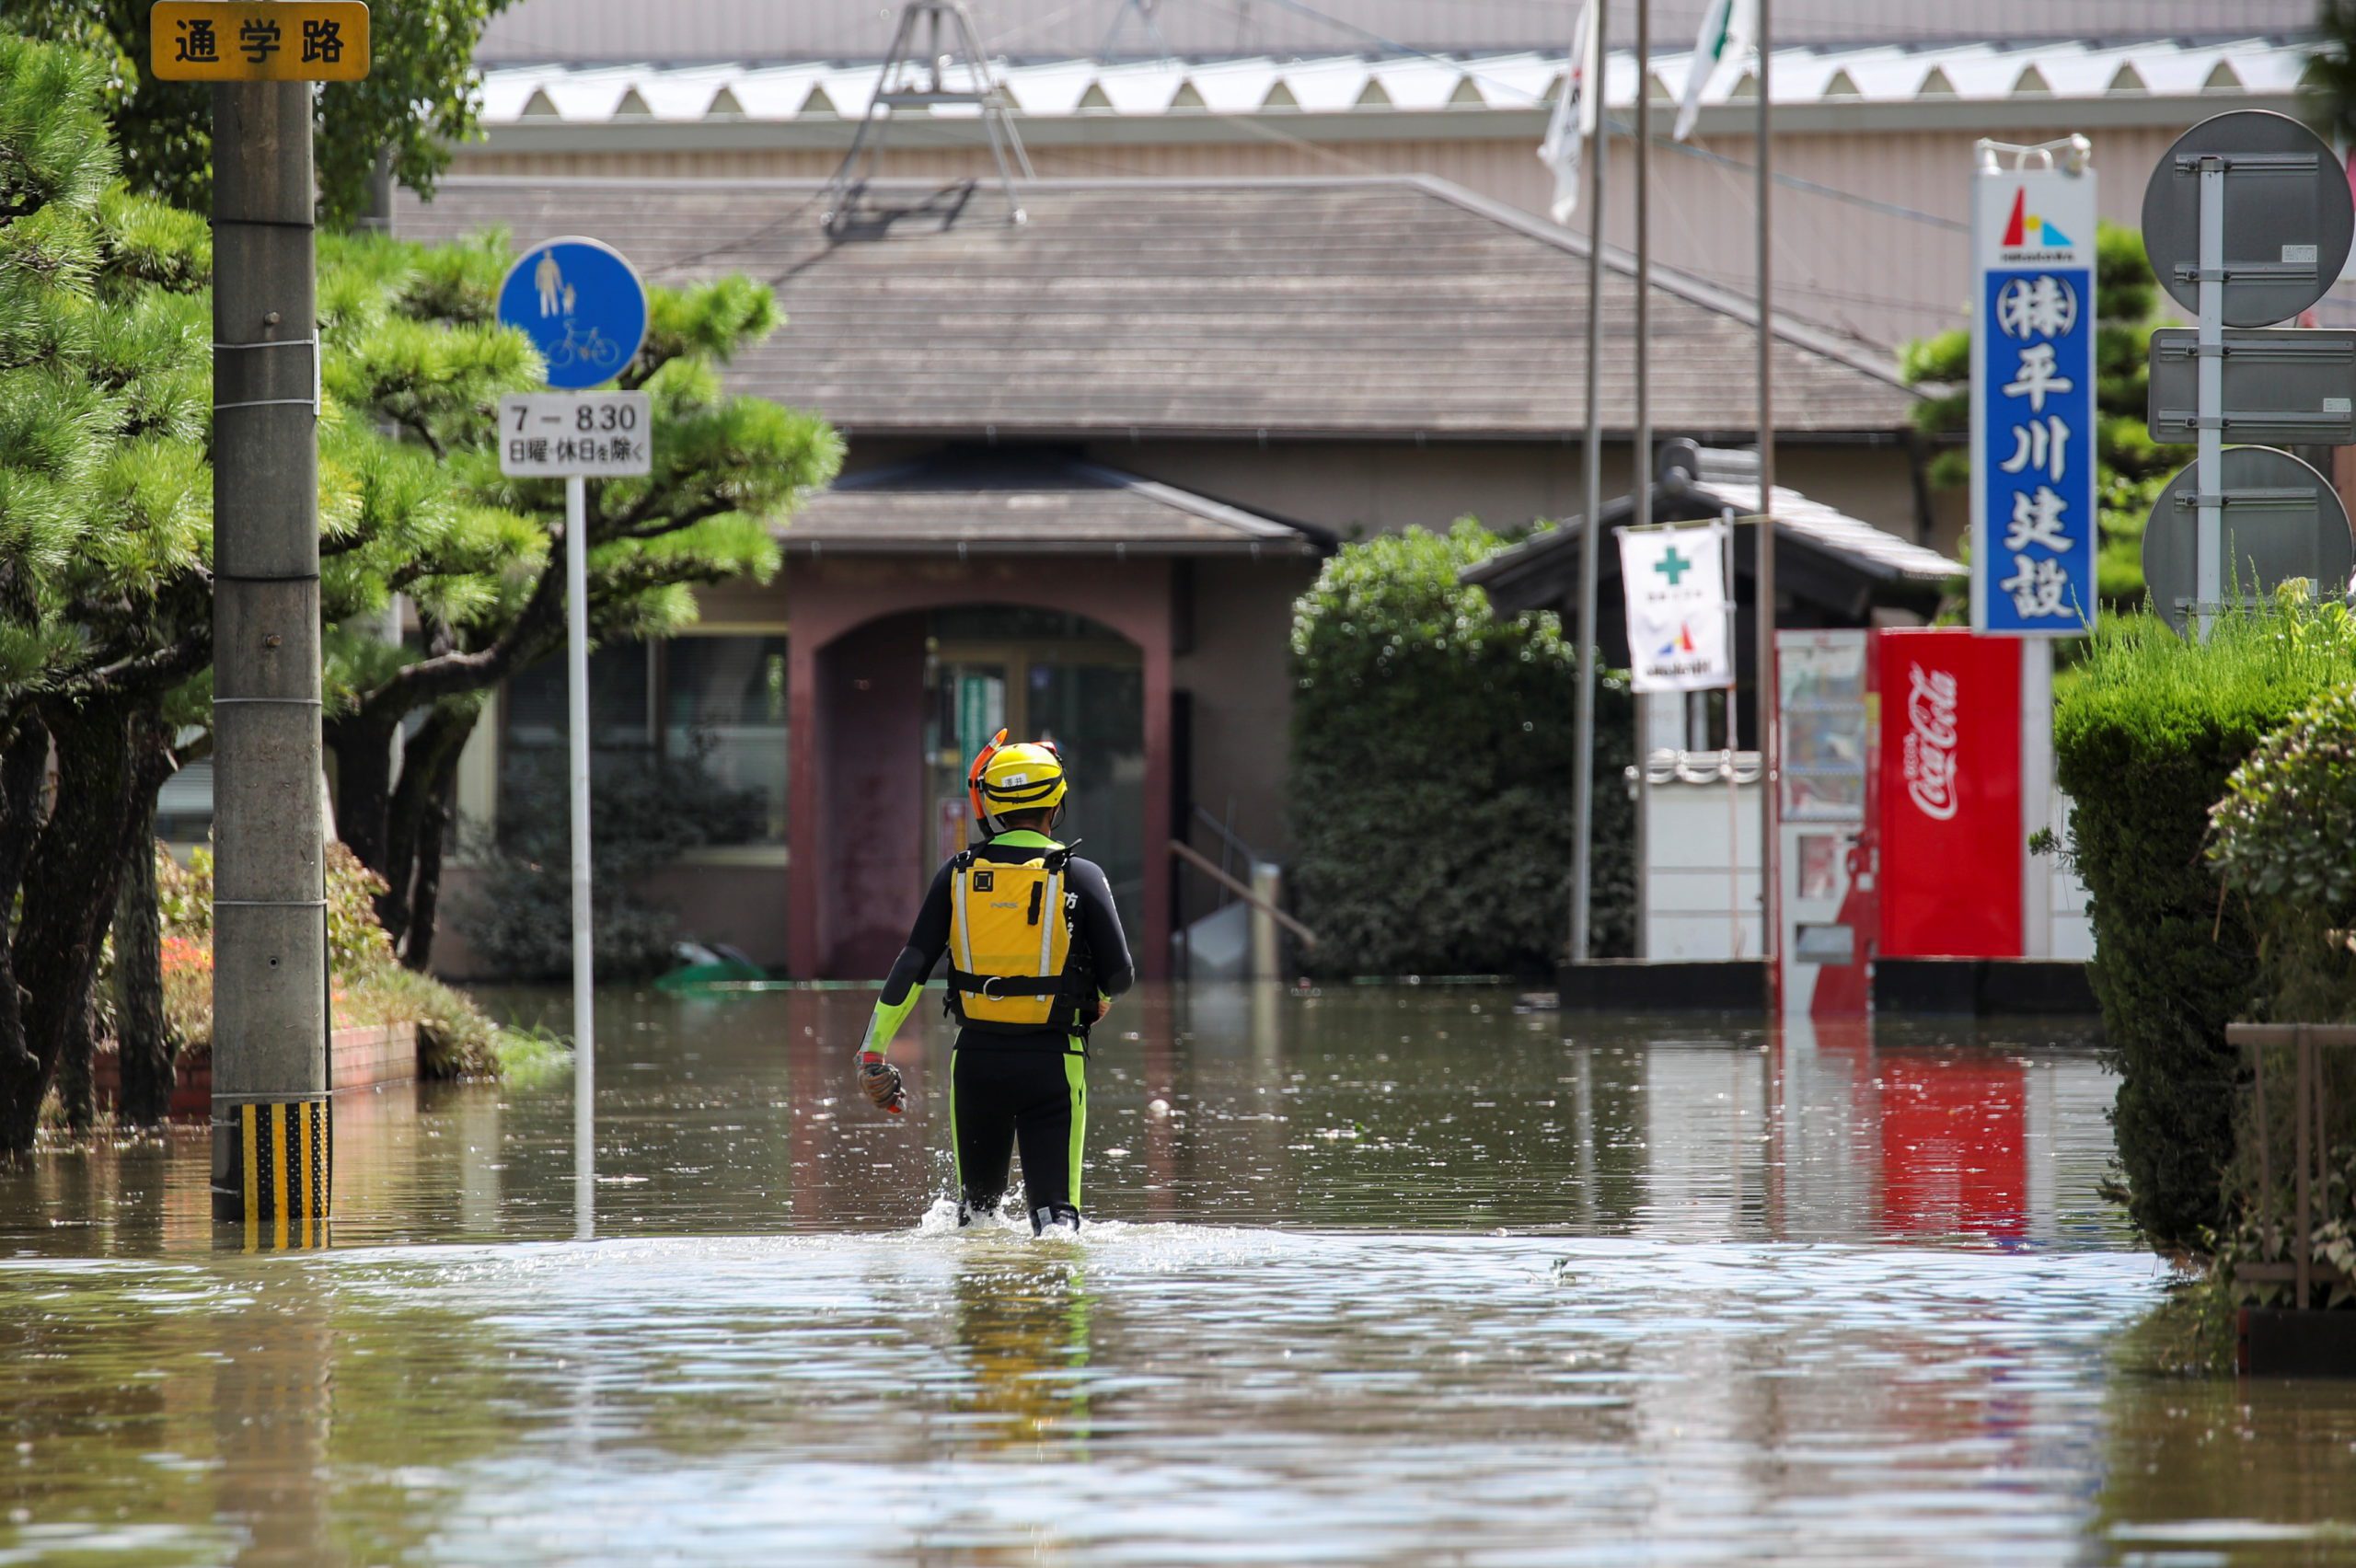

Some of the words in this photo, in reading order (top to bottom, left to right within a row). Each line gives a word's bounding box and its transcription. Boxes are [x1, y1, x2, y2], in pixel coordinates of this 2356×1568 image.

[175, 18, 345, 63] 通学路
[511, 405, 528, 432] 7
[1908, 659, 1958, 821] Coca-Cola
